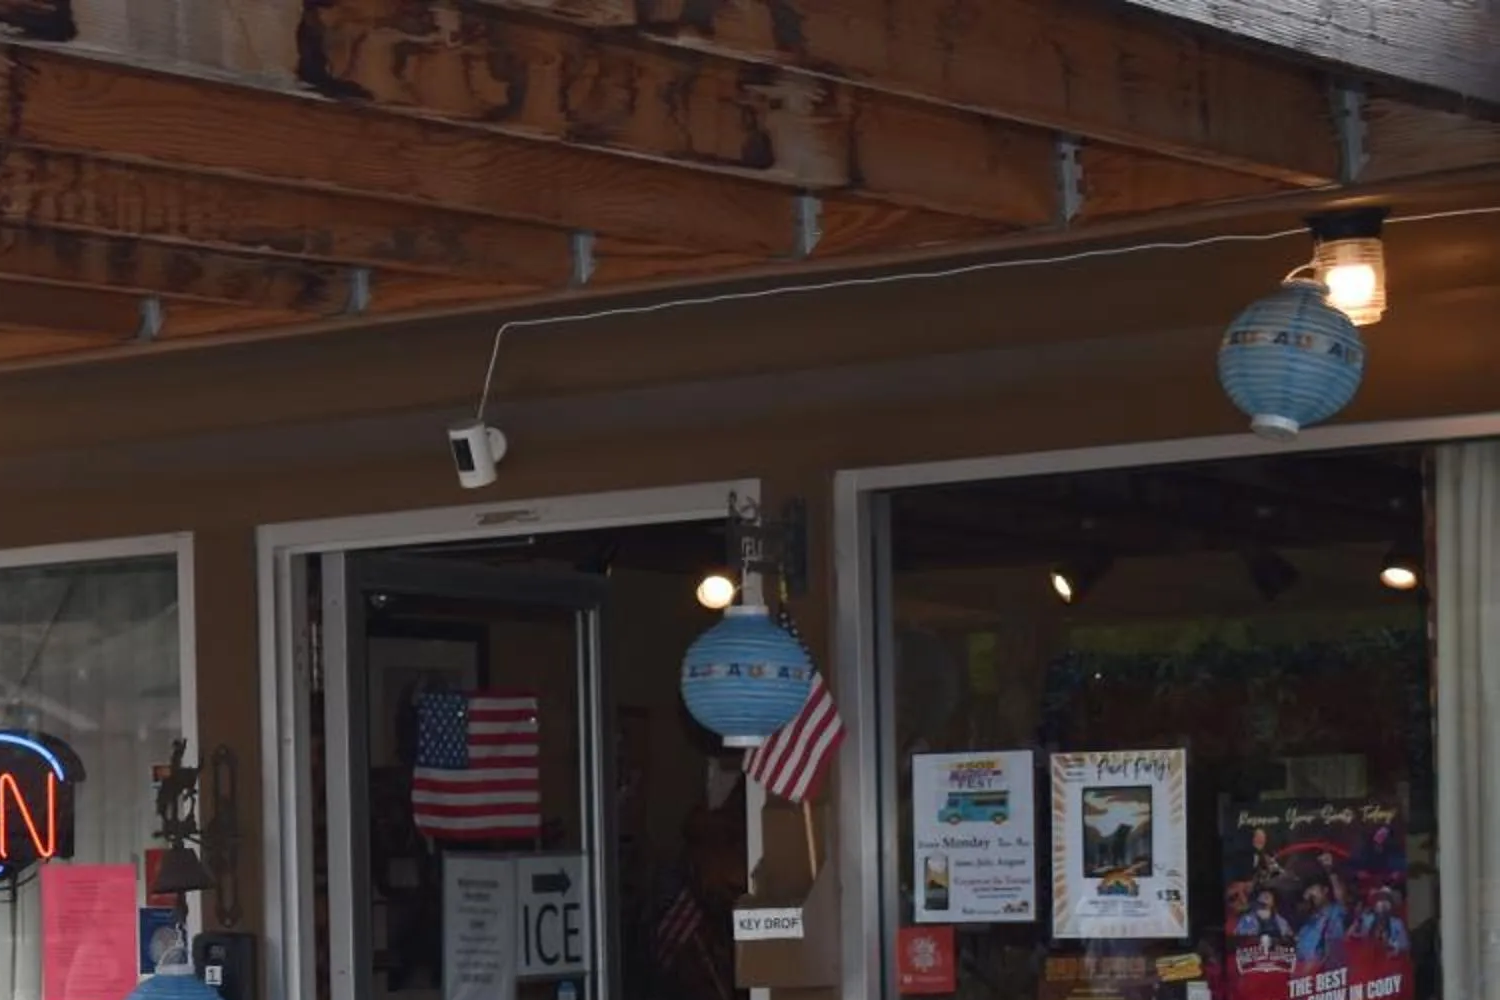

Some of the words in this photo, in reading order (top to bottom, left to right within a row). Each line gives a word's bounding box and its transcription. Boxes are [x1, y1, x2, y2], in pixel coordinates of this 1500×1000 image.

[942, 836, 991, 850] Monday
[739, 917, 761, 931] KEY
[523, 903, 583, 966] ICE
[208, 968, 220, 983] 1
[1288, 975, 1313, 998] THE
[1315, 967, 1348, 992] BEST
[1367, 975, 1403, 998] CODY
